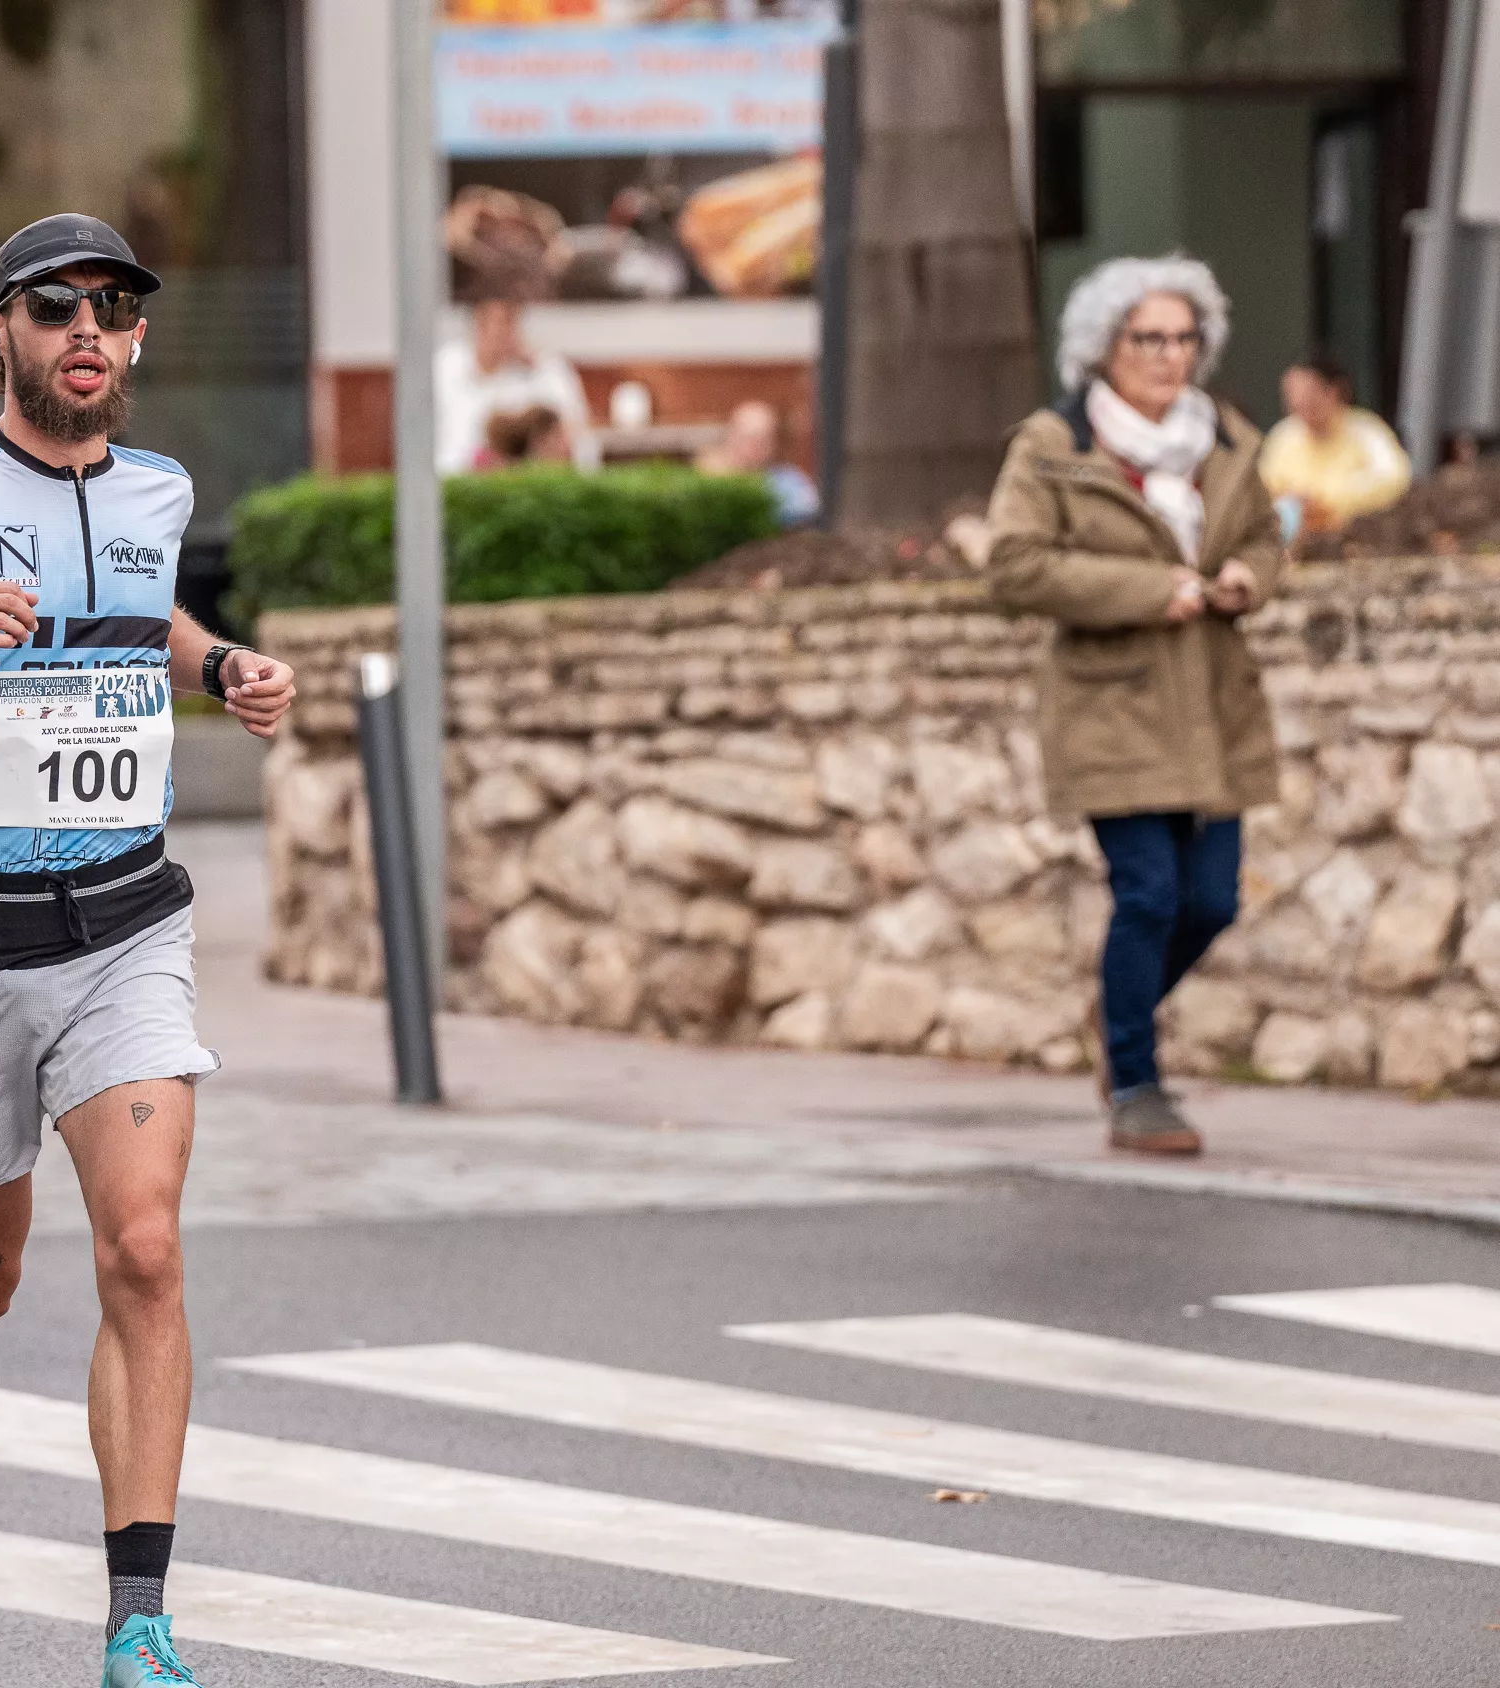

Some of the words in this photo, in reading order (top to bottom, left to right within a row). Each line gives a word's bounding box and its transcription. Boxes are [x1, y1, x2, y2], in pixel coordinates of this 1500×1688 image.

[113, 566, 157, 574] Alcaudete
[35, 677, 80, 686] PROVINCIAL
[82, 676, 92, 685] DE
[93, 673, 138, 694] 2024
[45, 685, 92, 696] POPULARES
[59, 694, 93, 703] CÓRDOBA
[41, 727, 57, 735] XXV
[111, 725, 138, 733] LUCENA
[84, 736, 121, 744] IGUALDAD
[38, 749, 138, 802] 100
[49, 816, 73, 824] MANU
[74, 816, 97, 824] CANO
